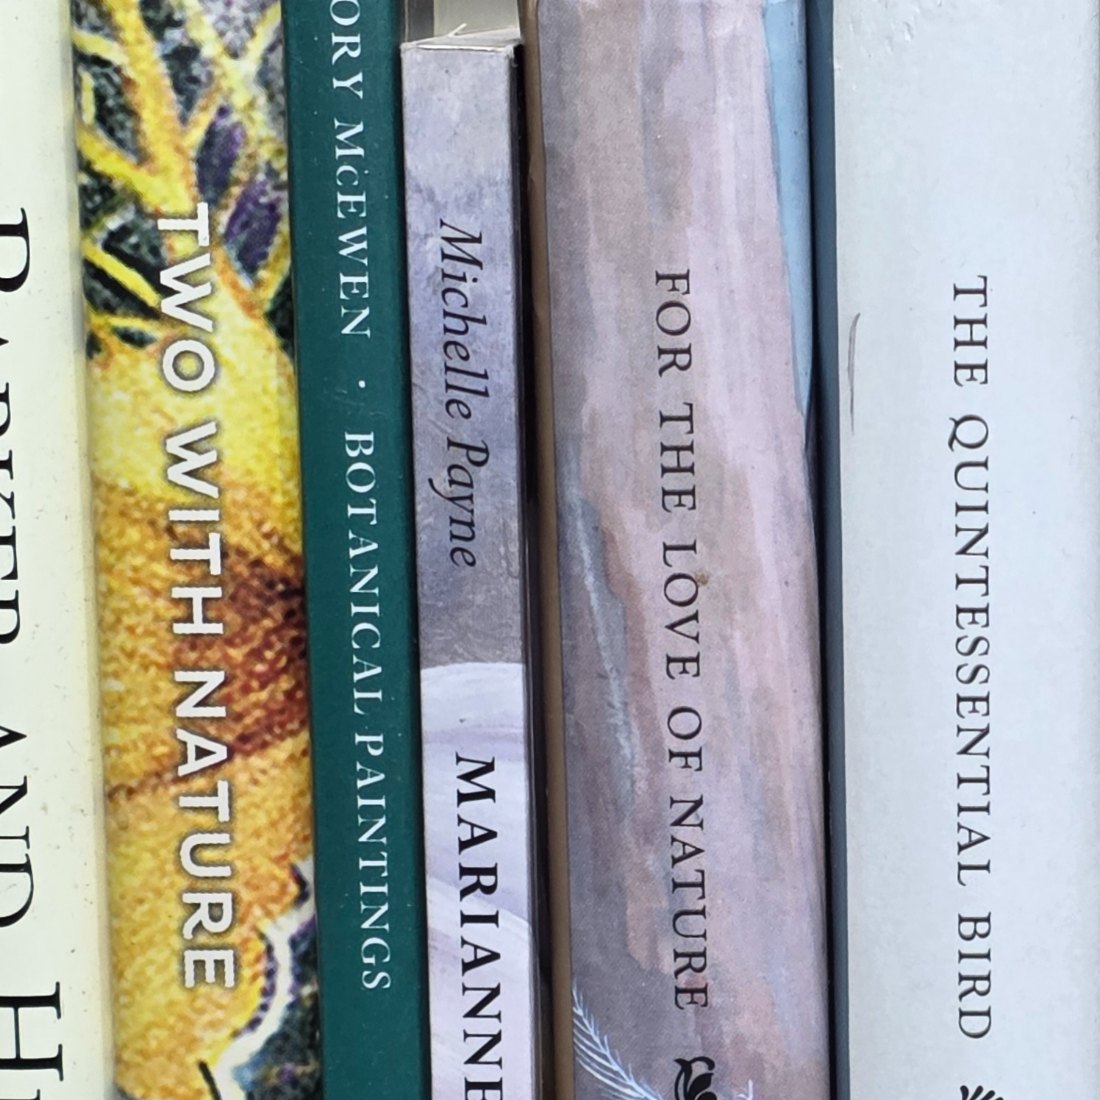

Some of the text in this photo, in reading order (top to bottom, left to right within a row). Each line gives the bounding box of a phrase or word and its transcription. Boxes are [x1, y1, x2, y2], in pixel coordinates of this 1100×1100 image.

[156, 202, 236, 991] TWO WITH NATURE
[342, 430, 386, 717] BOTANICAL
[427, 216, 490, 567] Michelle Payne
[654, 268, 711, 1011] FOR THE LOVE OF NATURE
[947, 274, 995, 1040] THE QUINTESSENTIAL BIRD
[354, 732, 392, 992] PAINTINGS
